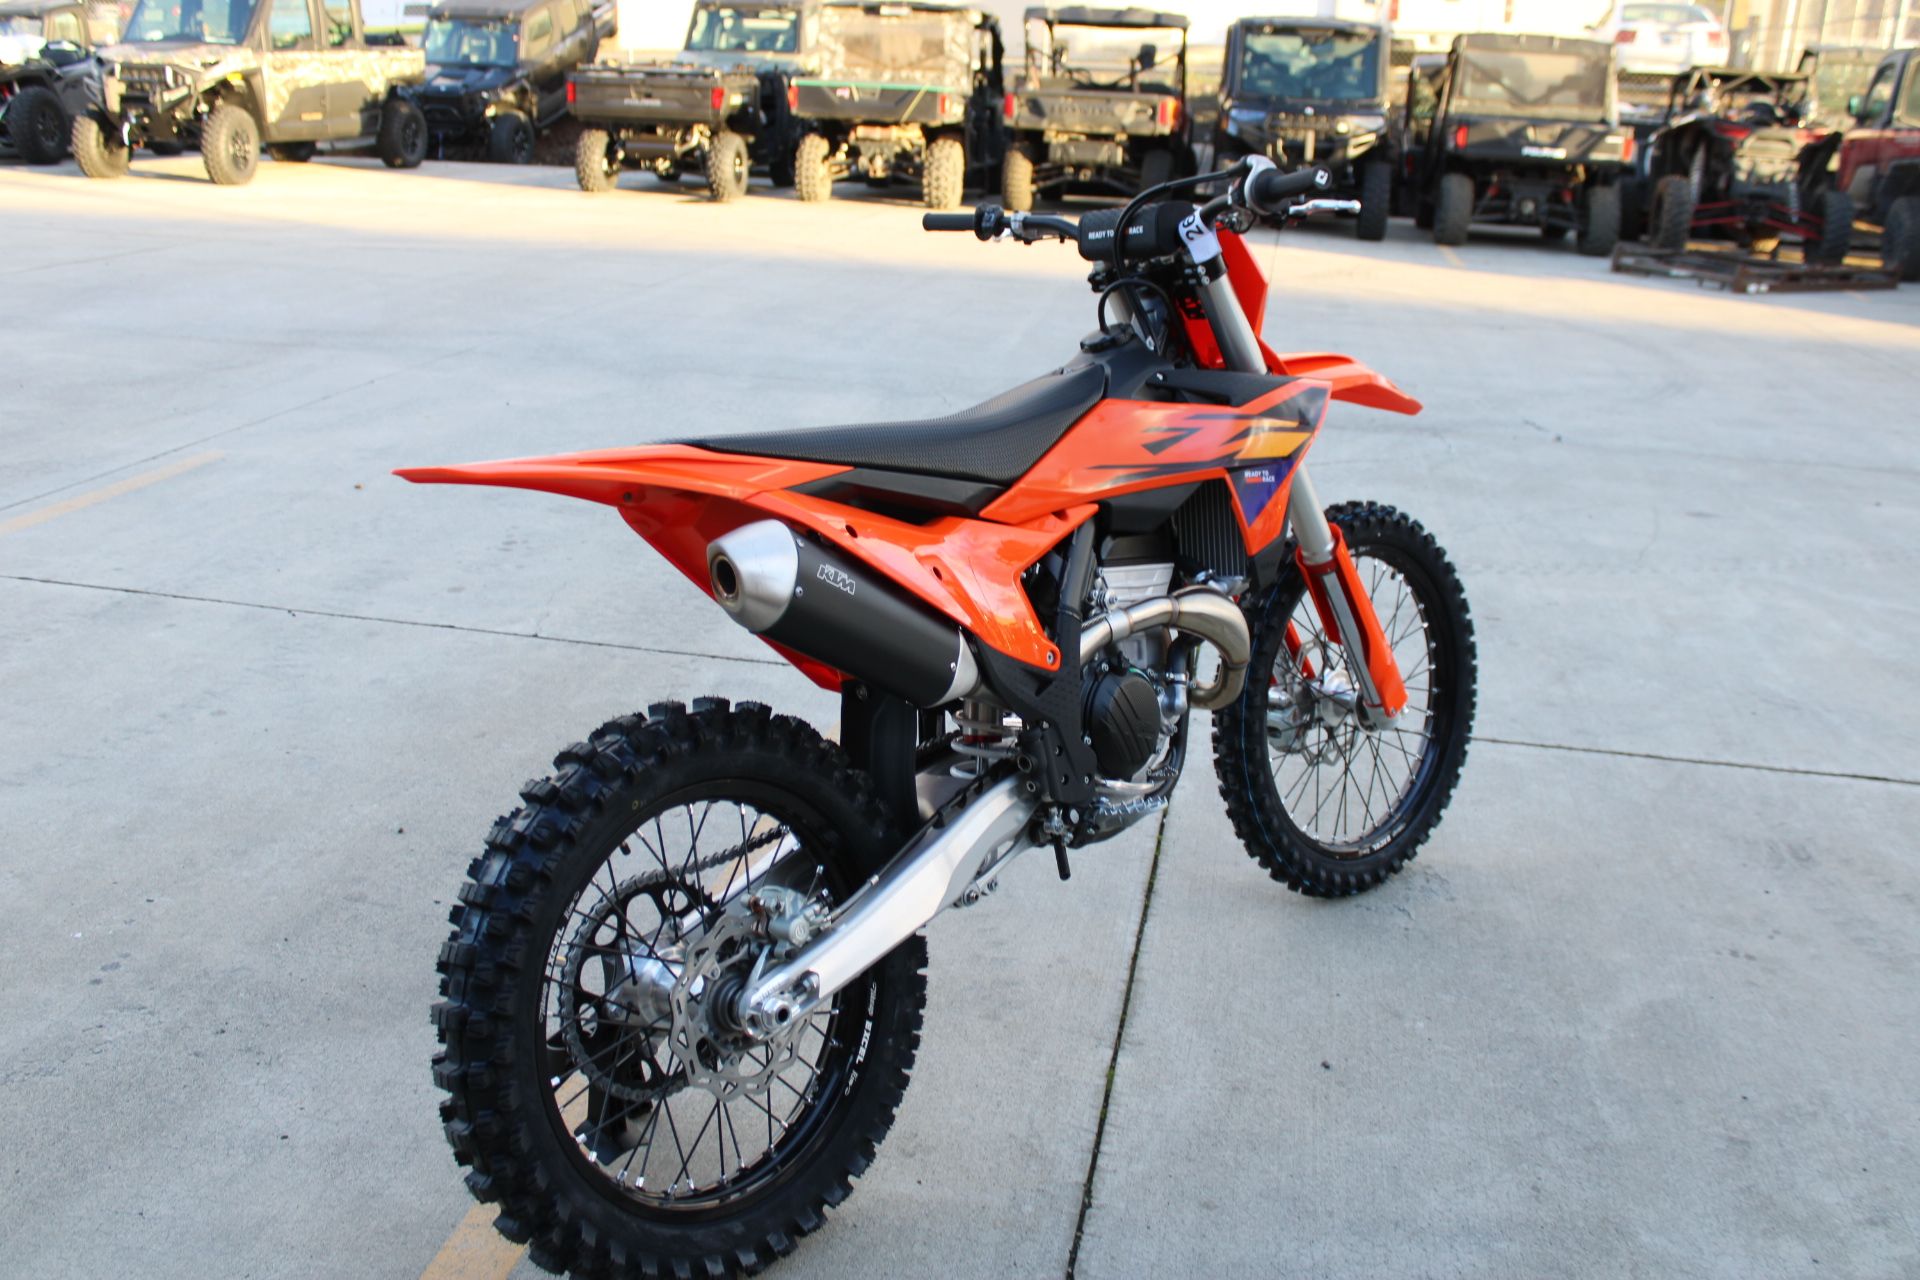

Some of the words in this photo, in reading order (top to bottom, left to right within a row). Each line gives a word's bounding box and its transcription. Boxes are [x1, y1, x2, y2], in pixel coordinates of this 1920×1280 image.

[1088, 231, 1106, 240] READY
[1106, 229, 1115, 238] TO
[1128, 225, 1144, 235] RACE
[1244, 470, 1261, 478] READY
[1262, 475, 1275, 483] RACE
[816, 563, 856, 595] KTM
[544, 926, 565, 977] EXCEL
[856, 1019, 873, 1065] EXCEL
